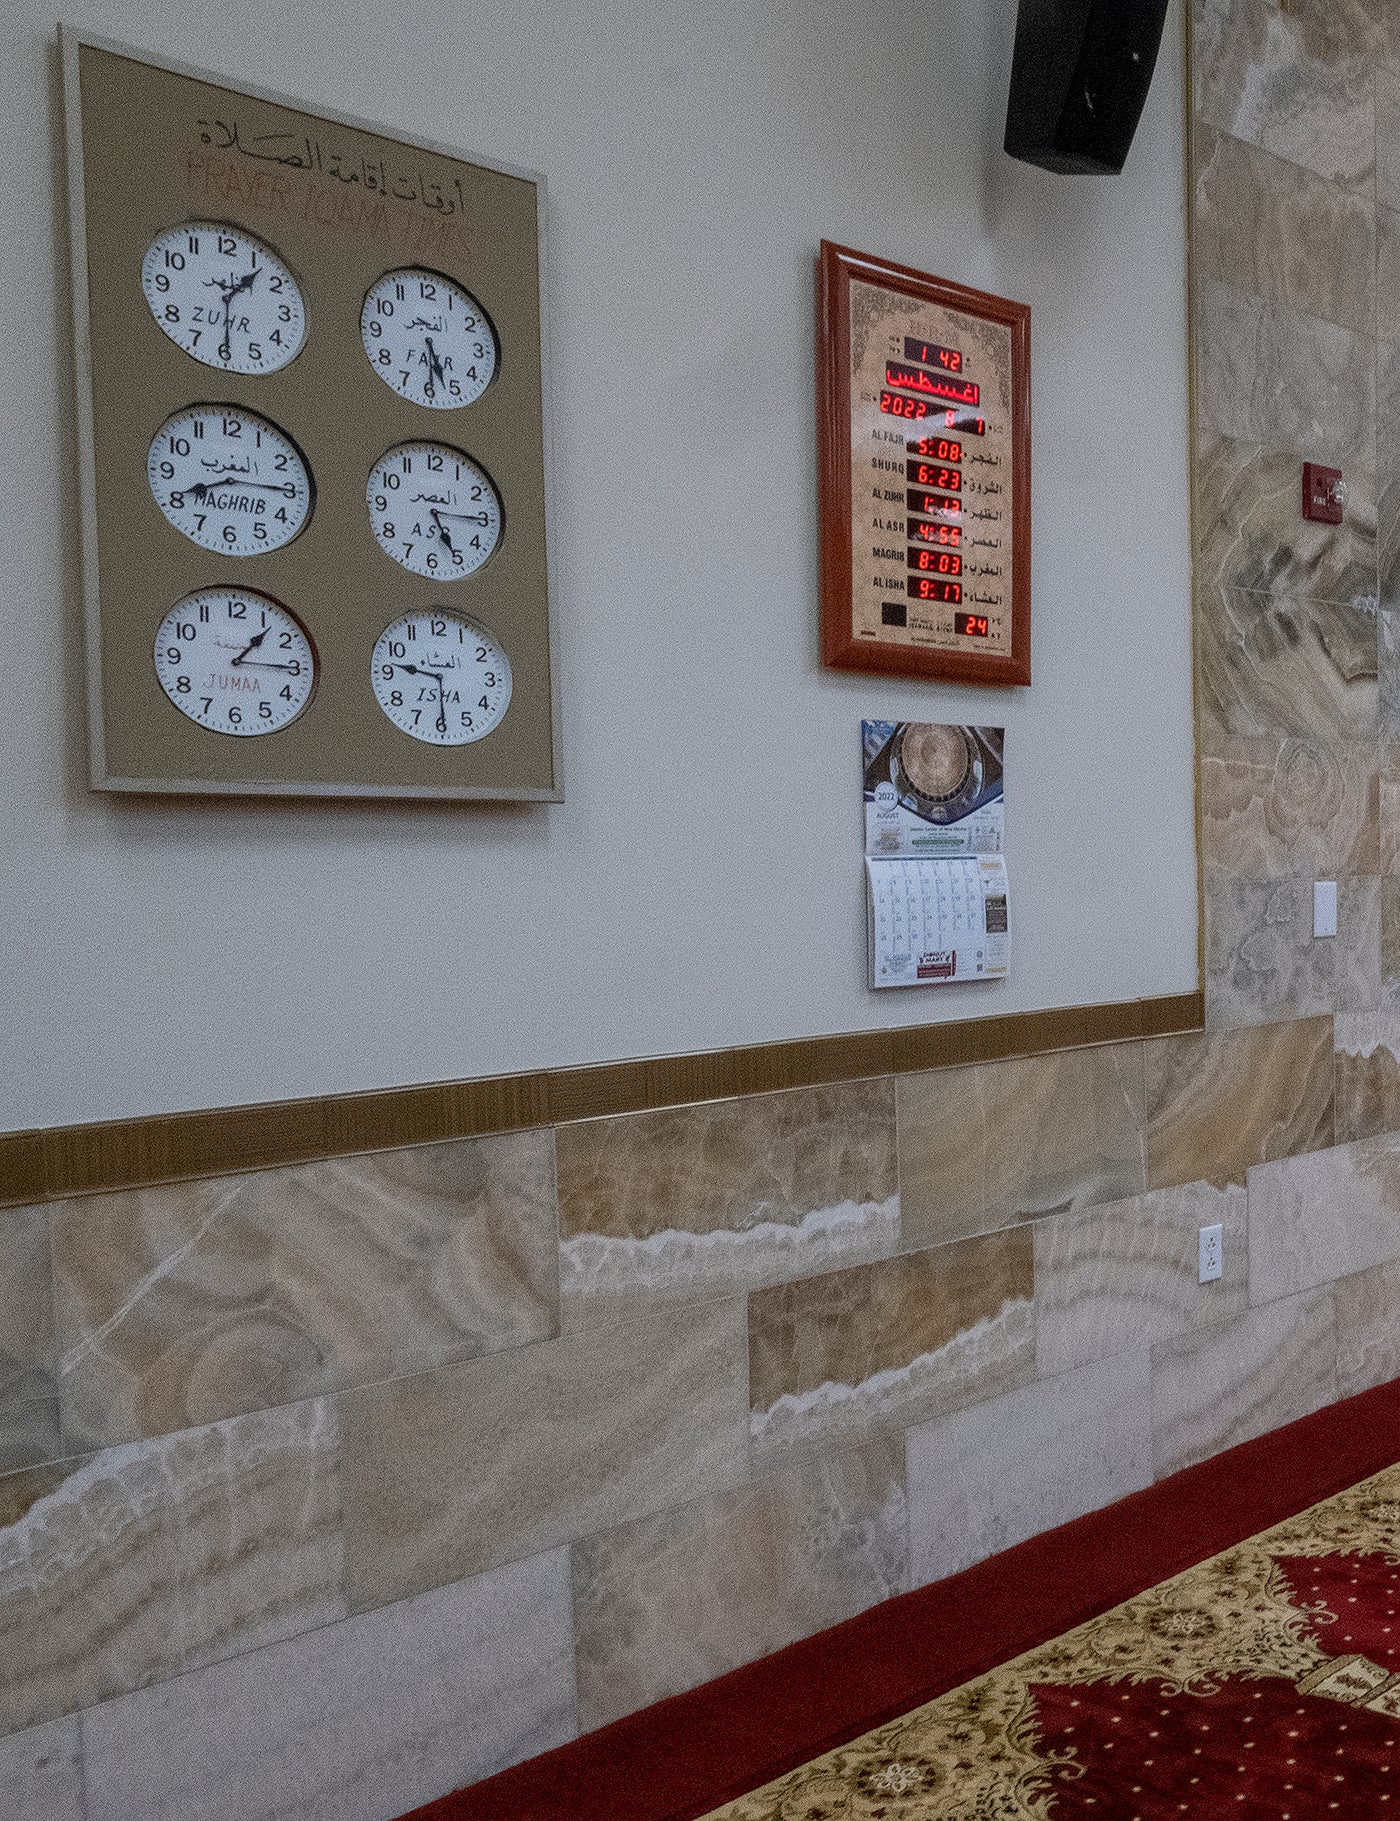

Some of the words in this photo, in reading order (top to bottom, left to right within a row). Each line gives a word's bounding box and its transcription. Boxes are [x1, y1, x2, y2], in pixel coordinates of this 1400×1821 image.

[328, 155, 387, 197] إقامة
[189, 236, 198, 254] 11
[219, 236, 236, 256] 12
[165, 250, 185, 270] 10
[156, 275, 169, 292] 9
[270, 276, 282, 294] 2
[396, 284, 404, 300] 11
[420, 283, 436, 301] 12
[165, 305, 179, 322] 8
[279, 305, 291, 322] 3
[377, 298, 394, 316] 10
[191, 306, 251, 333] ZUHR
[402, 315, 448, 332] الفجر
[465, 317, 475, 332] 2
[370, 321, 382, 337] 9
[190, 329, 201, 346] 7
[270, 330, 281, 345] 4
[218, 344, 231, 361] 6
[249, 343, 261, 360] 5
[379, 349, 391, 365] 8
[474, 343, 484, 358] 3
[939, 350, 961, 371] 42
[400, 371, 410, 386] 7
[467, 366, 477, 381] 4
[424, 382, 435, 398] 6
[450, 380, 461, 395] 5
[880, 393, 927, 420] 2022
[194, 421, 203, 438] 11
[223, 418, 241, 438] 12
[170, 437, 190, 456] 10
[160, 462, 174, 479] 9
[201, 455, 259, 476] المغرب
[275, 454, 287, 471] 2
[403, 457, 411, 473] 11
[428, 454, 443, 472] 12
[383, 472, 400, 490] 10
[918, 465, 960, 490] 6:23
[284, 482, 296, 498] 3
[410, 489, 457, 506] العصر
[471, 486, 482, 501] 2
[872, 488, 882, 500] AL
[170, 491, 184, 508] 8
[194, 489, 267, 515] MAGHRIB
[375, 496, 387, 511] 9
[194, 514, 206, 531] 7
[275, 507, 287, 523] 4
[476, 512, 488, 527] 3
[254, 523, 267, 539] 5
[383, 523, 395, 538] 8
[872, 518, 883, 529] AL
[223, 526, 236, 542] 6
[470, 535, 480, 549] 4
[919, 523, 960, 547] 4:55
[403, 543, 413, 558] 7
[452, 549, 463, 565] 5
[427, 553, 437, 568] 6
[918, 551, 960, 575] 8:03
[919, 579, 960, 603] 9:17
[200, 605, 209, 622] 11
[229, 601, 246, 619] 12
[177, 622, 196, 640] 10
[408, 625, 416, 640] 11
[431, 620, 446, 636] 12
[965, 616, 988, 635] 24
[280, 633, 292, 649] 2
[167, 648, 181, 664] 9
[389, 641, 405, 658] 10
[476, 647, 486, 662] 2
[420, 651, 462, 668] العشاء
[287, 660, 300, 676] 3
[382, 665, 393, 680] 9
[177, 676, 191, 693] 8
[485, 672, 495, 687] 3
[280, 685, 292, 701] 4
[391, 691, 403, 706] 8
[416, 687, 462, 704] ISHA
[201, 697, 212, 714] 7
[259, 702, 272, 718] 5
[478, 696, 488, 709] 4
[229, 707, 241, 723] 6
[411, 710, 421, 724] 7
[462, 712, 472, 726] 5
[436, 716, 447, 732] 6
[878, 792, 895, 801] 2022
